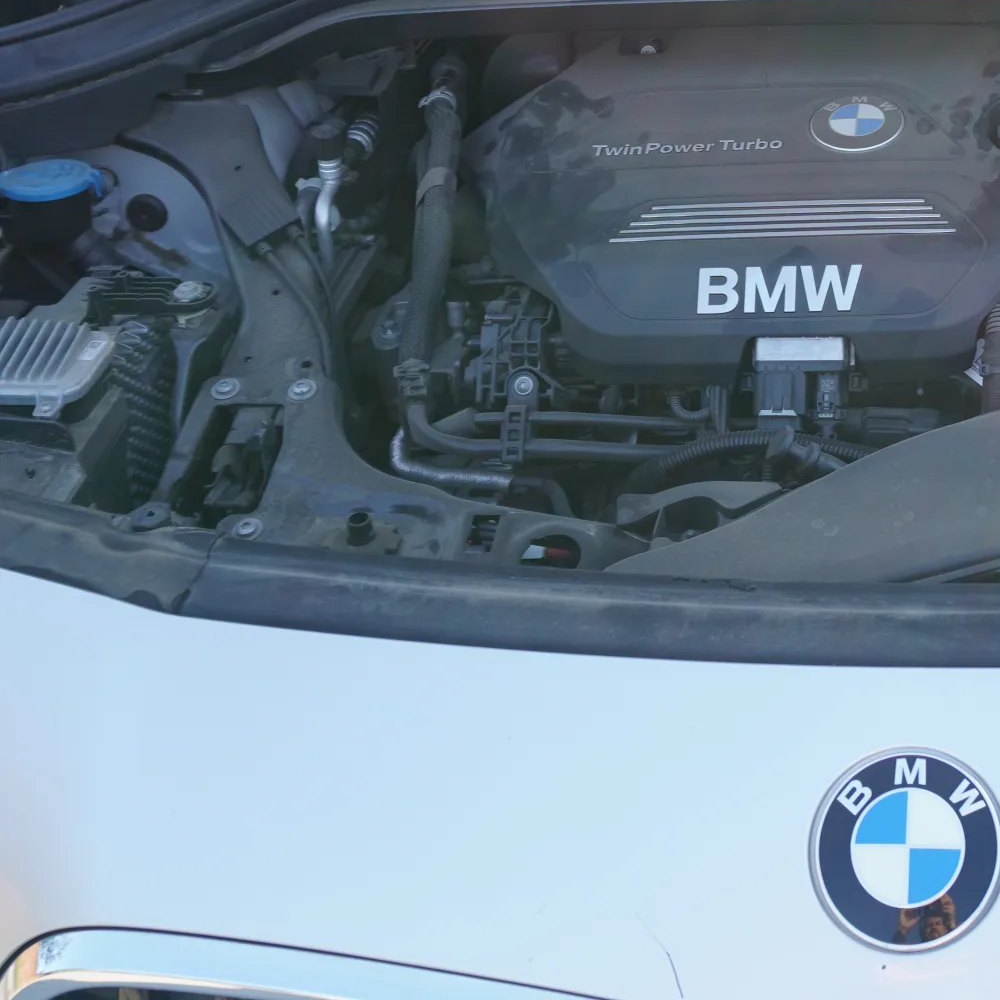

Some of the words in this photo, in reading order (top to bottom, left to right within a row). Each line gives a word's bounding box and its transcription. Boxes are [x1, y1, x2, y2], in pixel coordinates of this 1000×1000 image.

[823, 96, 897, 112] BMW
[719, 138, 783, 151] Turbo
[697, 264, 863, 314] BMW
[836, 757, 987, 817] BMW
